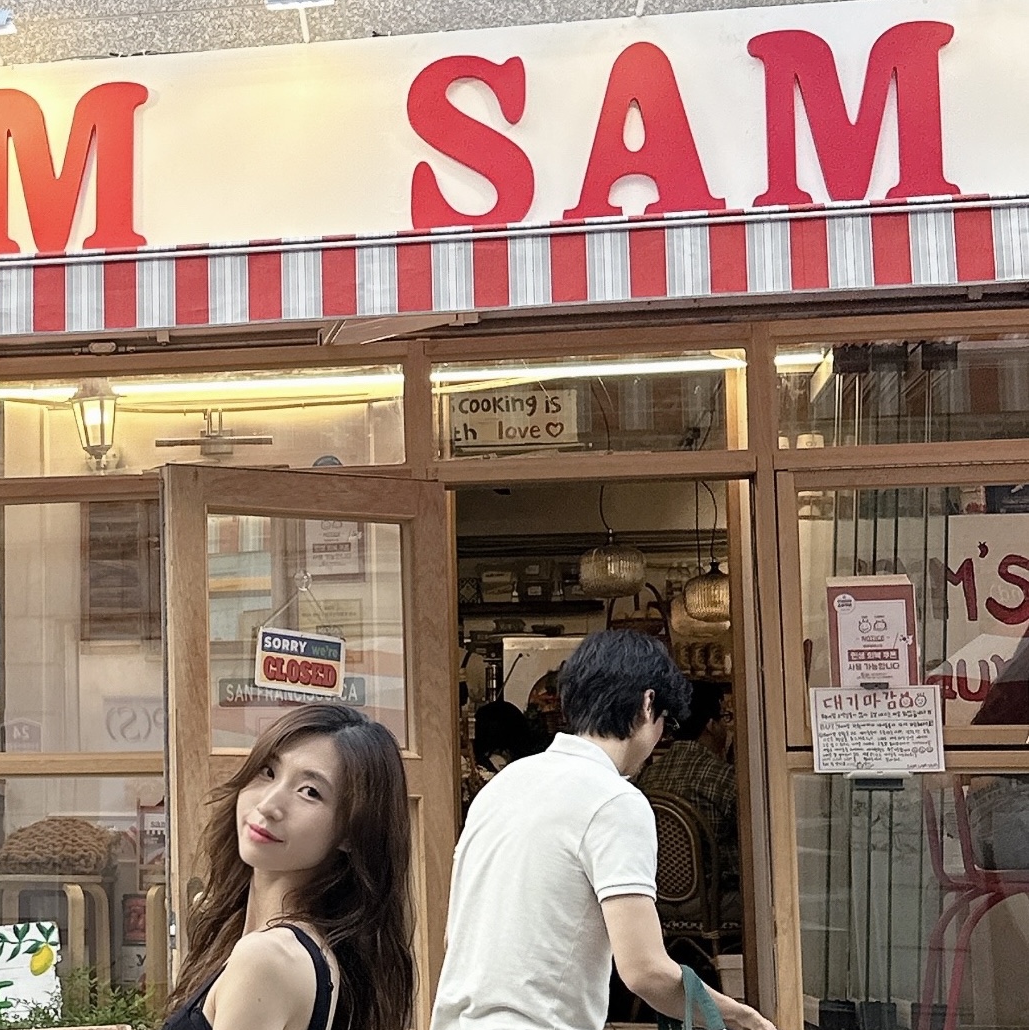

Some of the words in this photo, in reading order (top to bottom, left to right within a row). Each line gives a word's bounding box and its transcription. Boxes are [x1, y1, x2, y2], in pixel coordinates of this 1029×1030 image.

[406, 20, 961, 232] SAM
[458, 395, 537, 417] cooking
[545, 395, 562, 413] is
[497, 420, 541, 440] love
[264, 636, 308, 653] SORRY
[311, 645, 339, 658] we're
[263, 656, 337, 688] CLOSED
[226, 684, 253, 702] SAN
